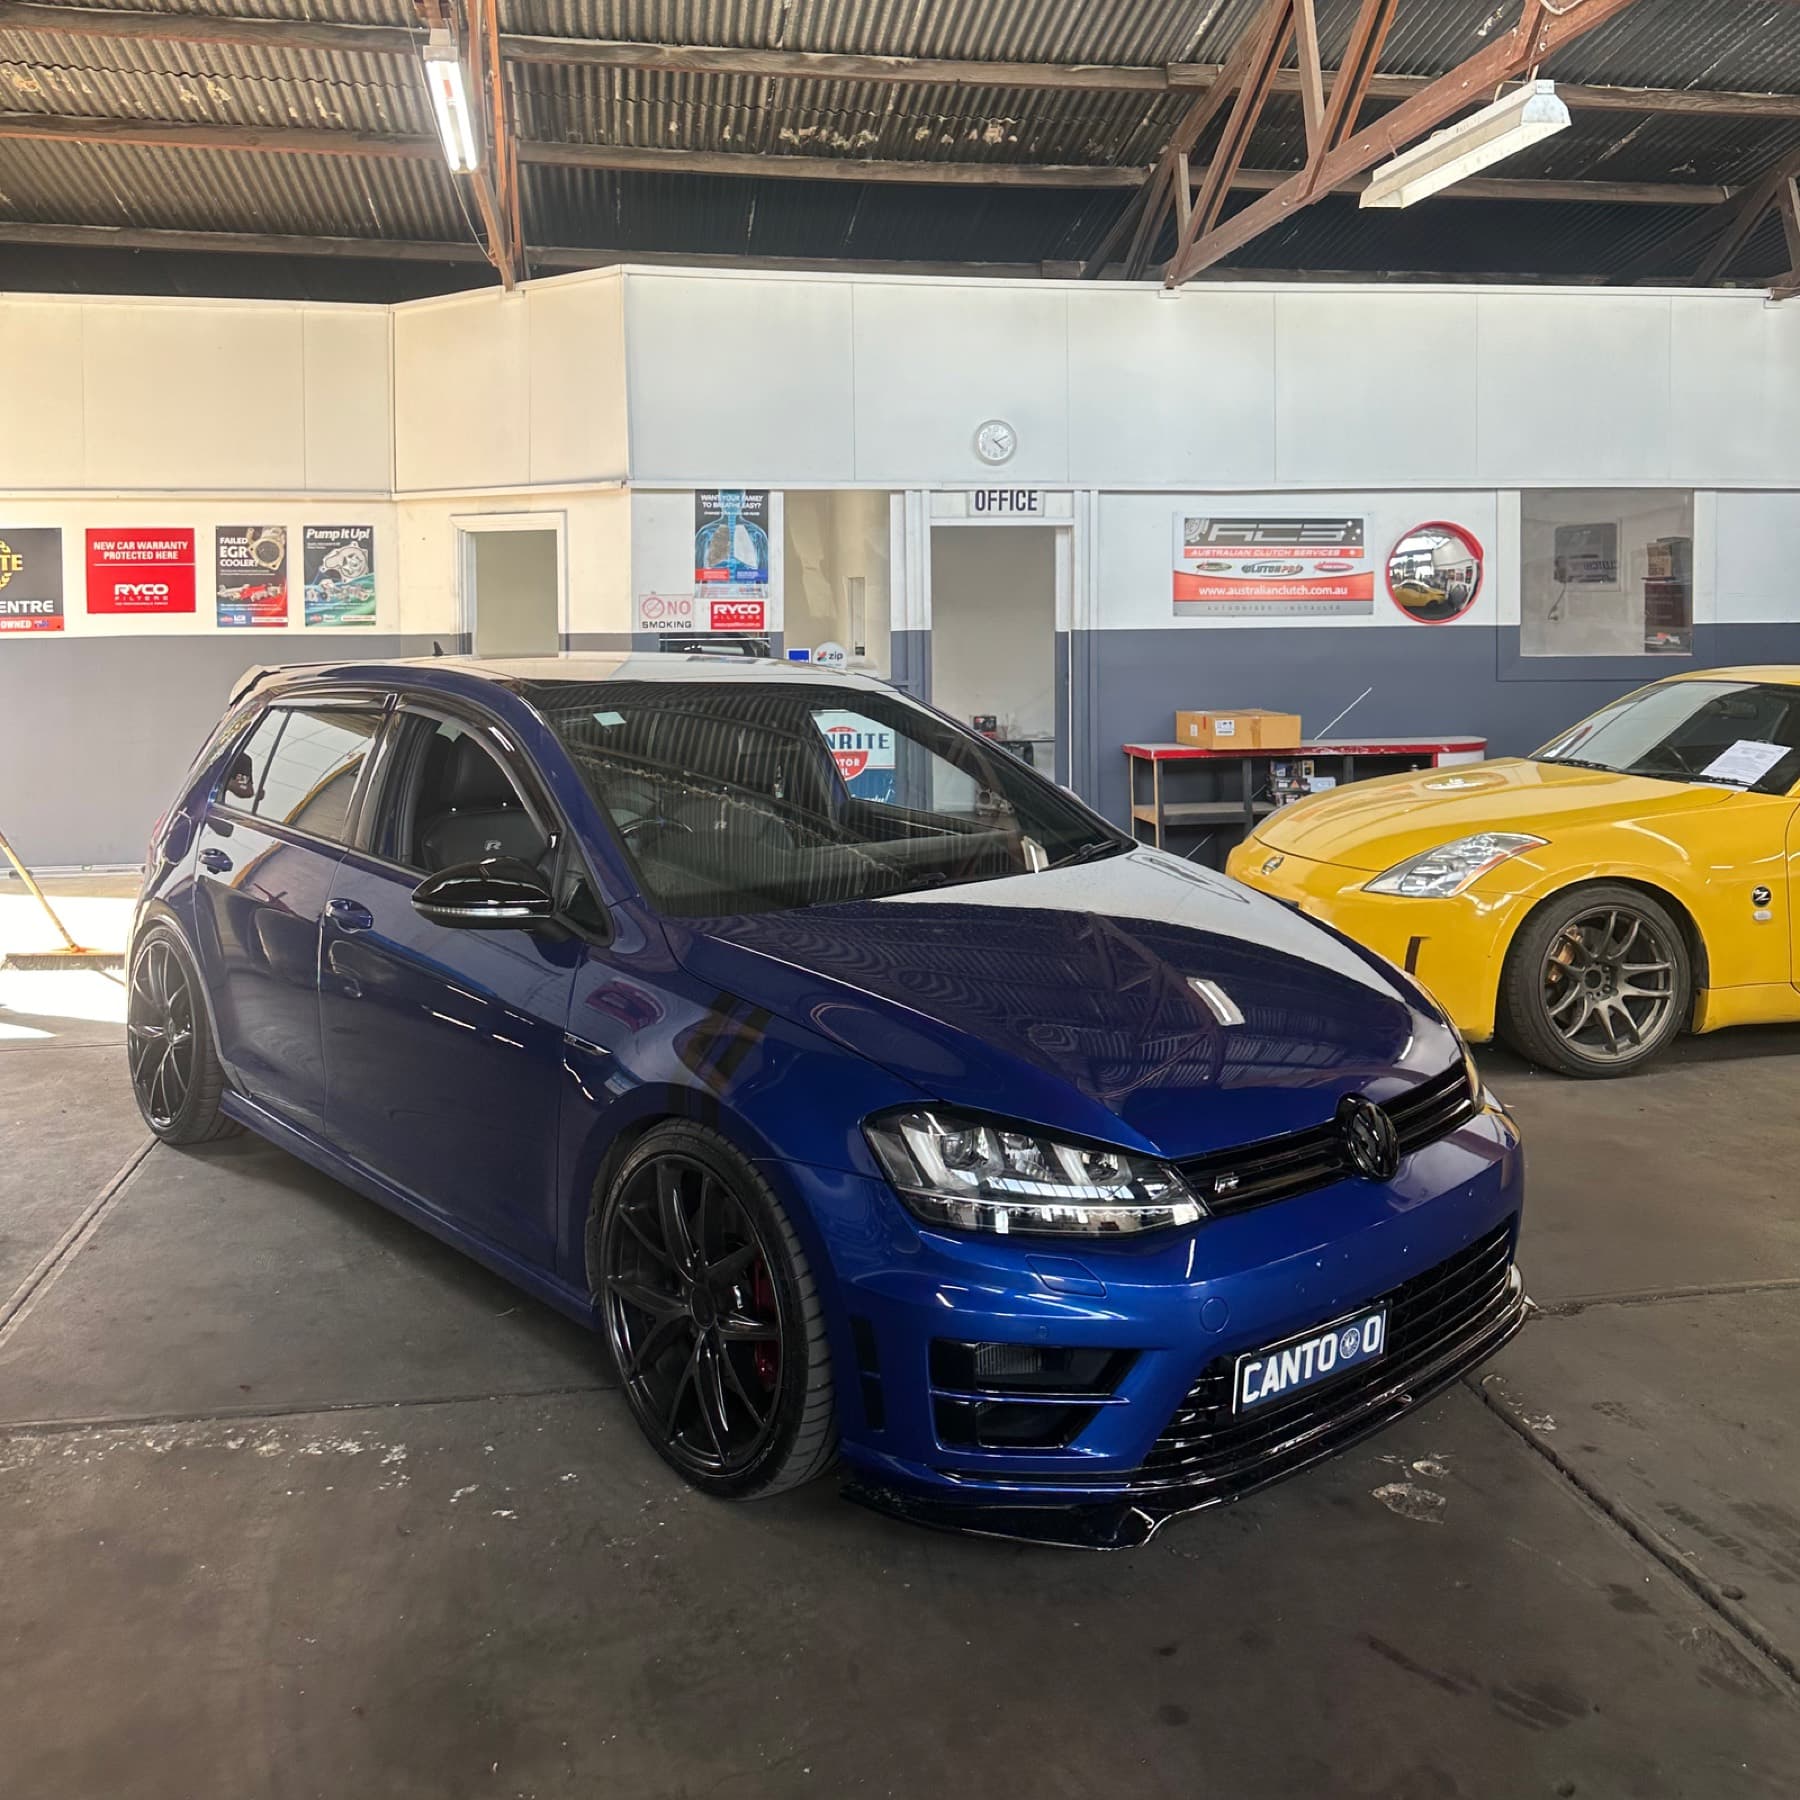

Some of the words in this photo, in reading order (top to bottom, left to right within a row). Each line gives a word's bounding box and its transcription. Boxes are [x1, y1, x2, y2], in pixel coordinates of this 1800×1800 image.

[700, 494, 720, 502] WANT
[975, 489, 1037, 511] OFFICE
[306, 528, 341, 541] Pump
[341, 528, 350, 539] It
[350, 528, 370, 541] Up!
[1208, 523, 1347, 542] ACS
[93, 541, 115, 550] NEW
[117, 541, 135, 550] CAR
[136, 541, 188, 550] WARRANTY
[103, 551, 154, 560] PROTECTED
[155, 551, 179, 560] HERE
[219, 545, 248, 558] EGR
[1191, 549, 1251, 557] AUSTRALIAN
[1253, 549, 1292, 557] CLUTCH
[1293, 549, 1341, 557] SERVICES
[114, 583, 169, 595] RYCO
[1199, 584, 1348, 596] www.australianclutch.com.au
[667, 600, 692, 615] NO
[713, 604, 761, 614] RYCO
[0, 620, 32, 629] OWNED
[641, 620, 692, 629] SMOKING
[828, 650, 843, 661] zip
[835, 758, 860, 767] TOR
[1242, 1332, 1338, 1404] CANTO
